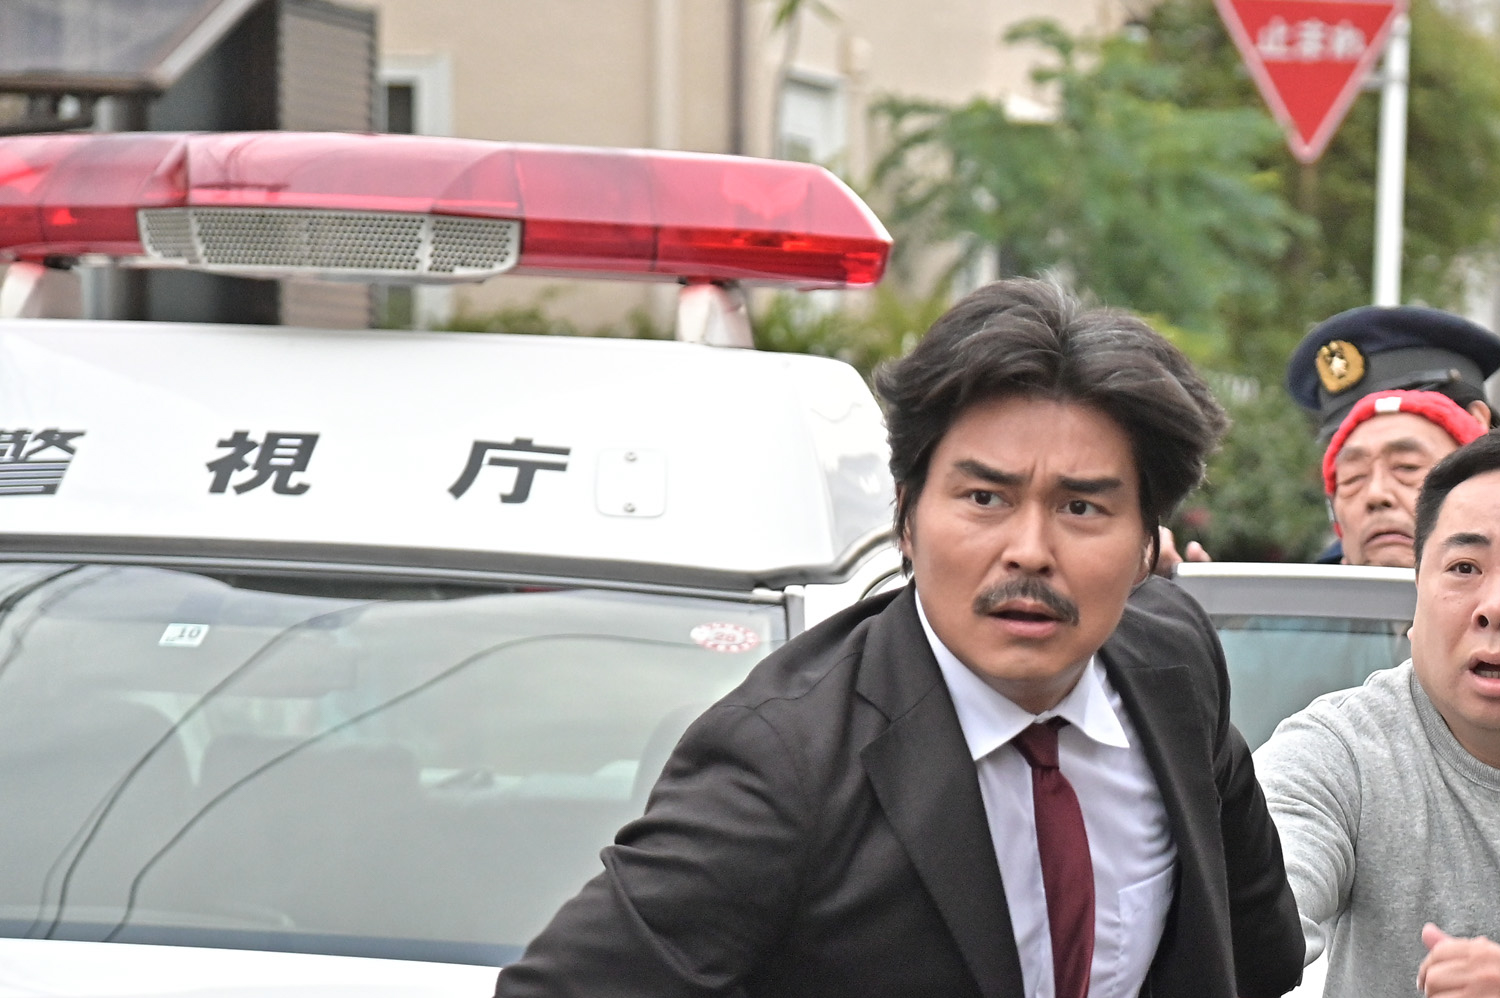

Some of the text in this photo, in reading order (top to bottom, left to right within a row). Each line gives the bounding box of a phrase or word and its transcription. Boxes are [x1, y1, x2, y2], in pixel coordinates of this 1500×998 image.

[1257, 16, 1367, 60] 止まれ
[178, 626, 203, 639] 10
